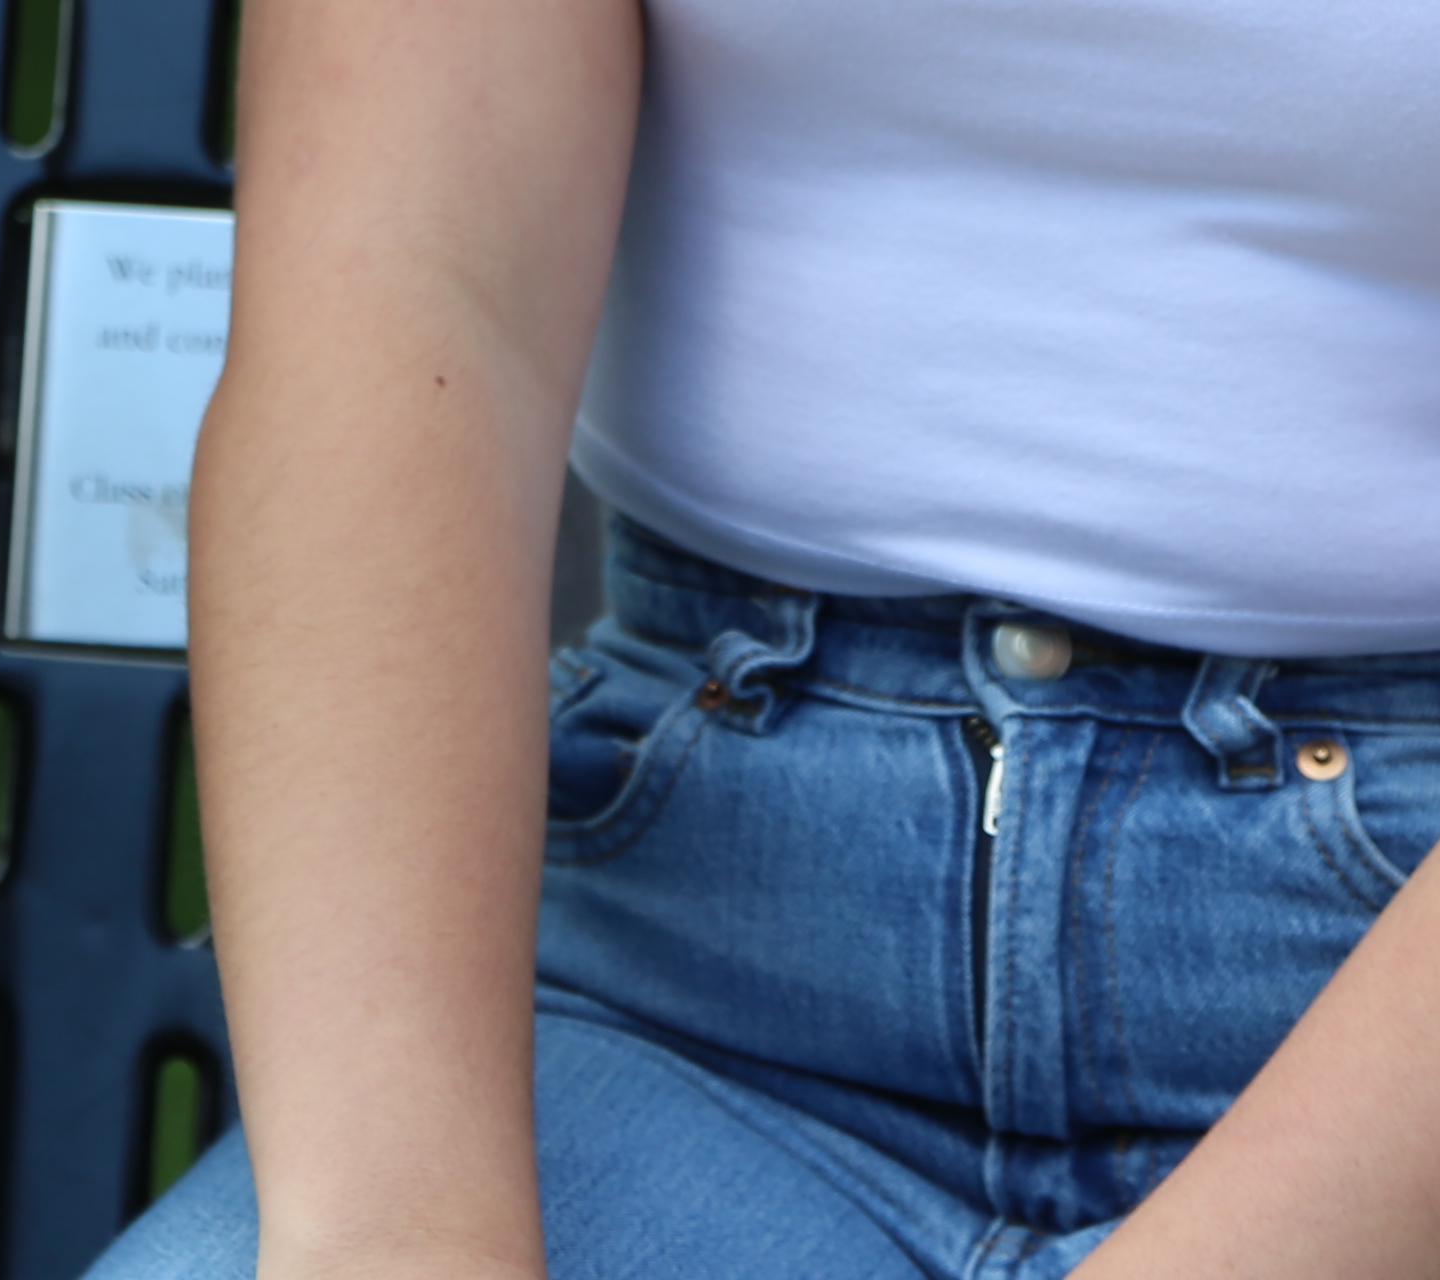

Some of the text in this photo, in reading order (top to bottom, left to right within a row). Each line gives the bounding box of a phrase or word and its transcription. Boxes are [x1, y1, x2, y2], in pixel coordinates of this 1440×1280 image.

[104, 256, 155, 287] We
[94, 320, 160, 352] and
[68, 473, 151, 505] Class
